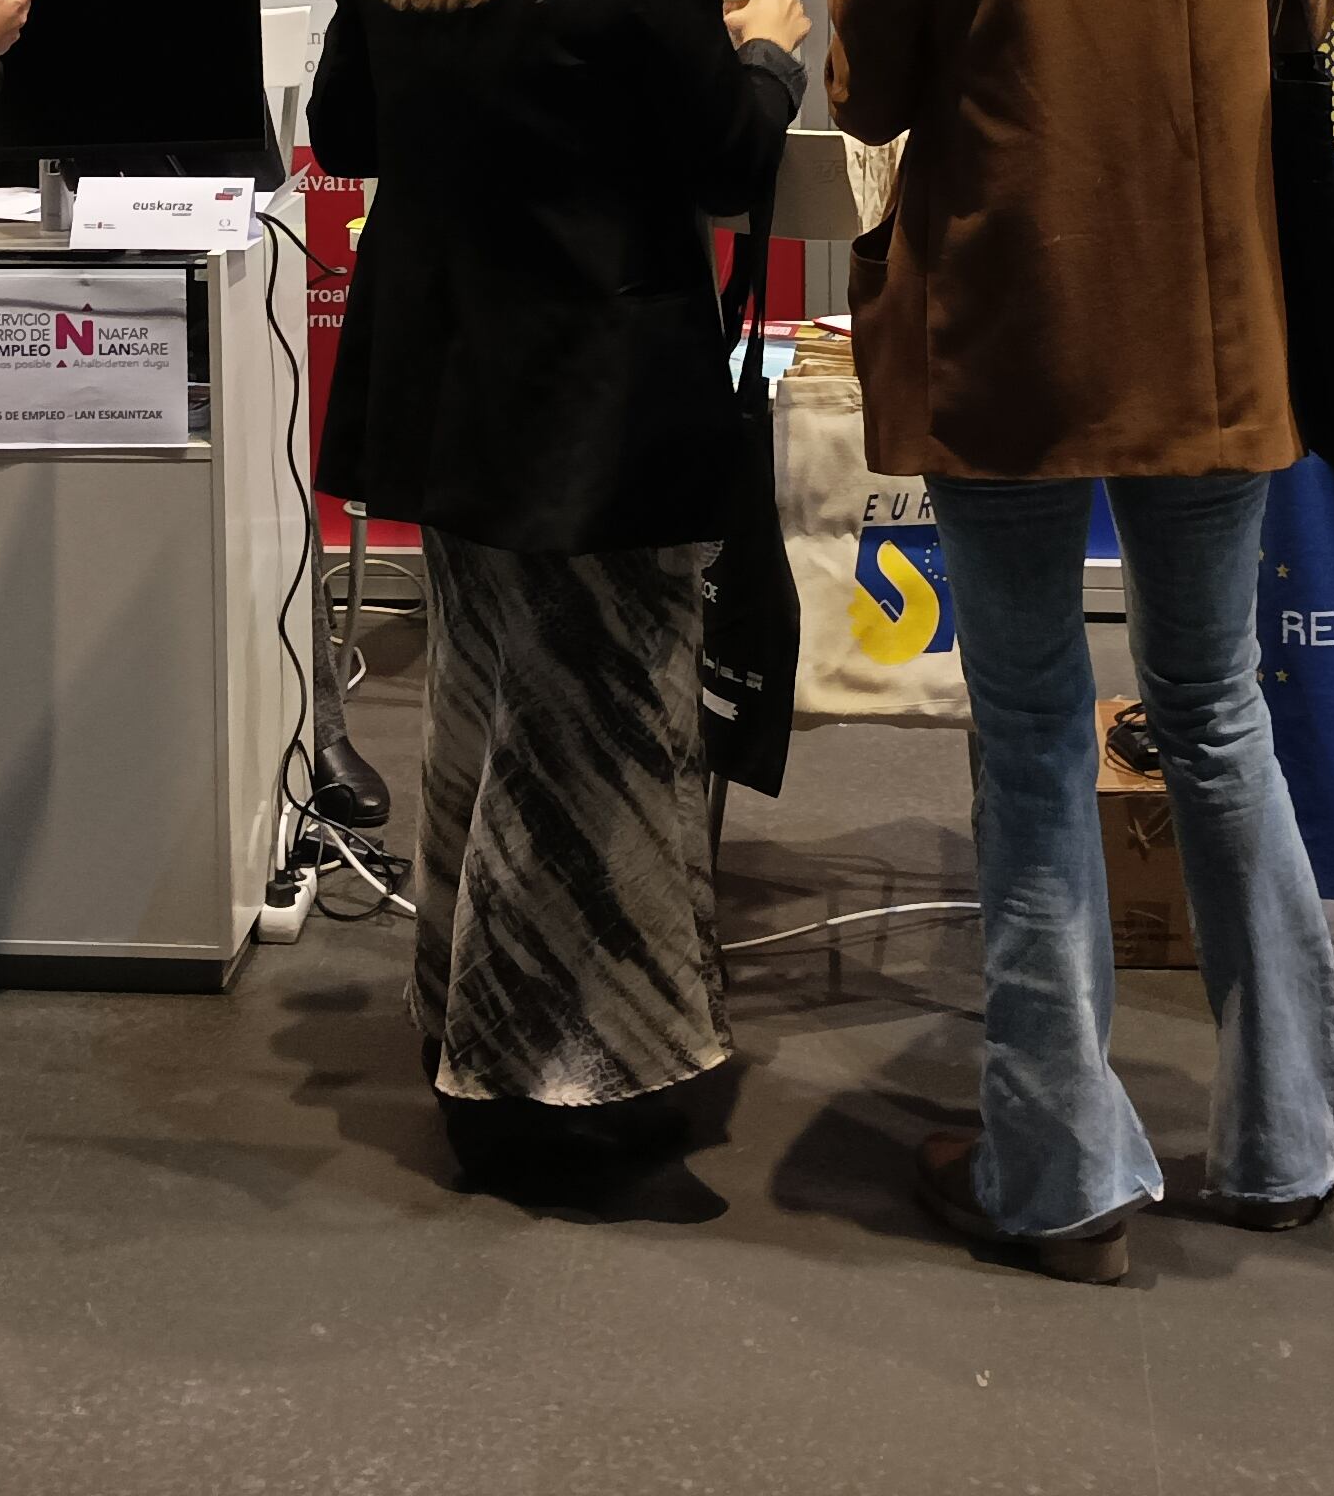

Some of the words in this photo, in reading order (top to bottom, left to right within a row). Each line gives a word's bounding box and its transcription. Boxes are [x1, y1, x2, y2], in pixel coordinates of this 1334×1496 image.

[133, 200, 193, 211] euskaraz
[31, 329, 50, 341] DE
[99, 328, 148, 340] NAFAR
[99, 343, 169, 355] LANSARE
[15, 360, 51, 370] posible
[5, 411, 18, 420] DE
[23, 410, 65, 420] EMPLEO
[75, 410, 95, 419] LAN
[99, 410, 162, 419] ESKAINTZAK
[863, 492, 931, 521] EUR
